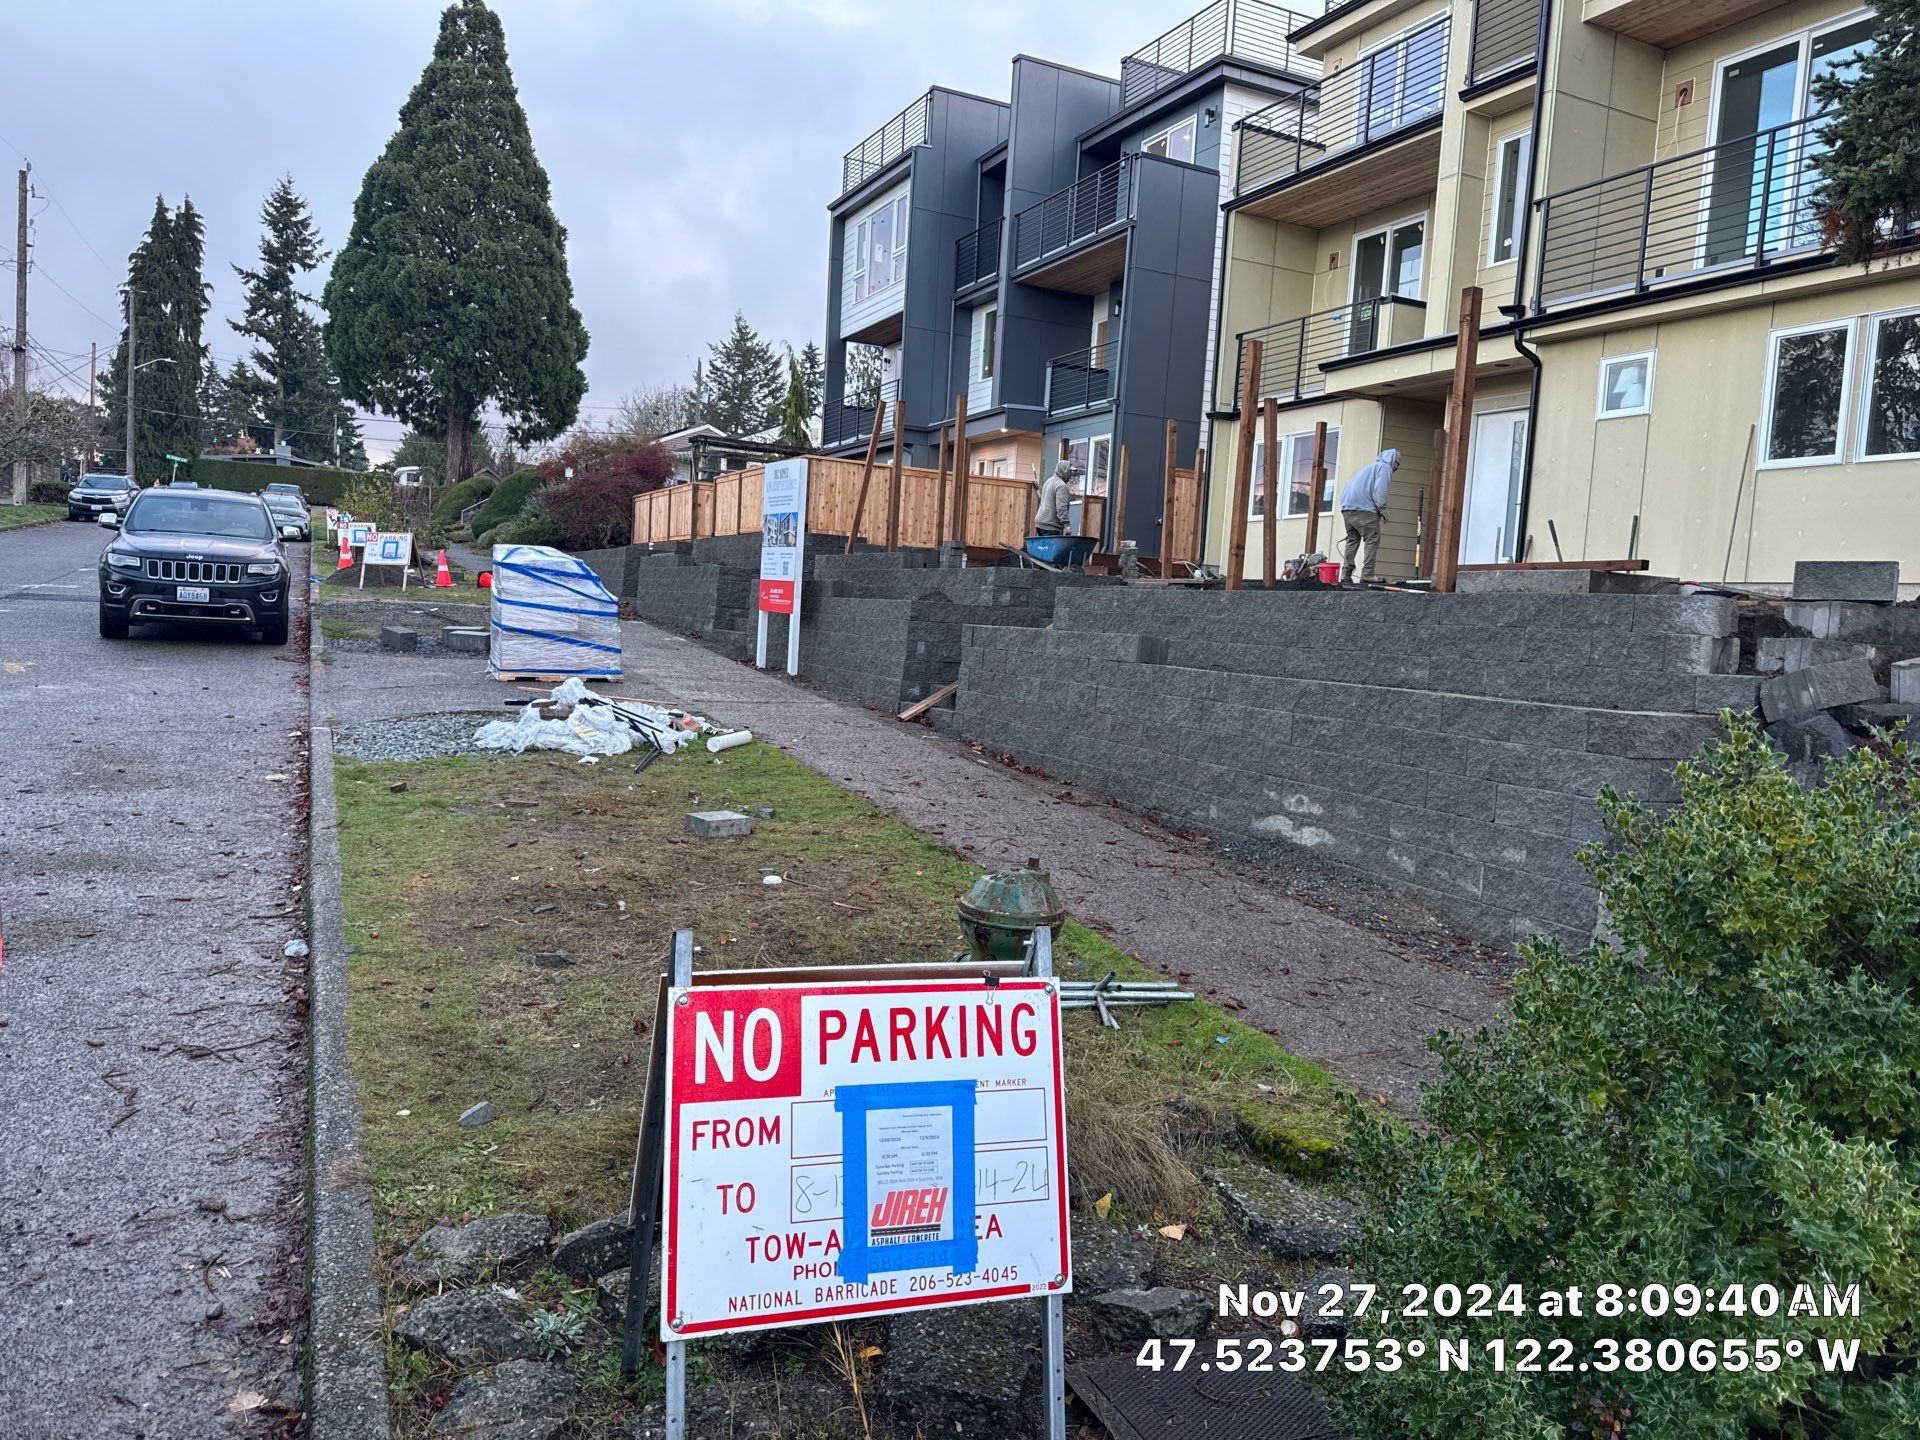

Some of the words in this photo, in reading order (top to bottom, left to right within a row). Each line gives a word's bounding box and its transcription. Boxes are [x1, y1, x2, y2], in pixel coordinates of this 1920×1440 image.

[366, 533, 378, 541] NO
[380, 534, 408, 542] PARKING
[694, 1008, 783, 1085] NO
[819, 1002, 1038, 1066] PARKING
[995, 1078, 1027, 1088] MARKER
[691, 1114, 782, 1151] FROM
[716, 1183, 756, 1215] TO
[871, 1187, 949, 1228] JIREH
[746, 1229, 842, 1264] TOW-A
[871, 1235, 901, 1246] ASPHALT
[907, 1232, 940, 1243] CONCRETE
[793, 1262, 838, 1281] PHO
[1031, 1282, 1047, 1292] 2022
[728, 1289, 803, 1314] NATIONAL
[815, 1277, 898, 1304] BARRICADE
[909, 1265, 1019, 1293] 206-523-4045
